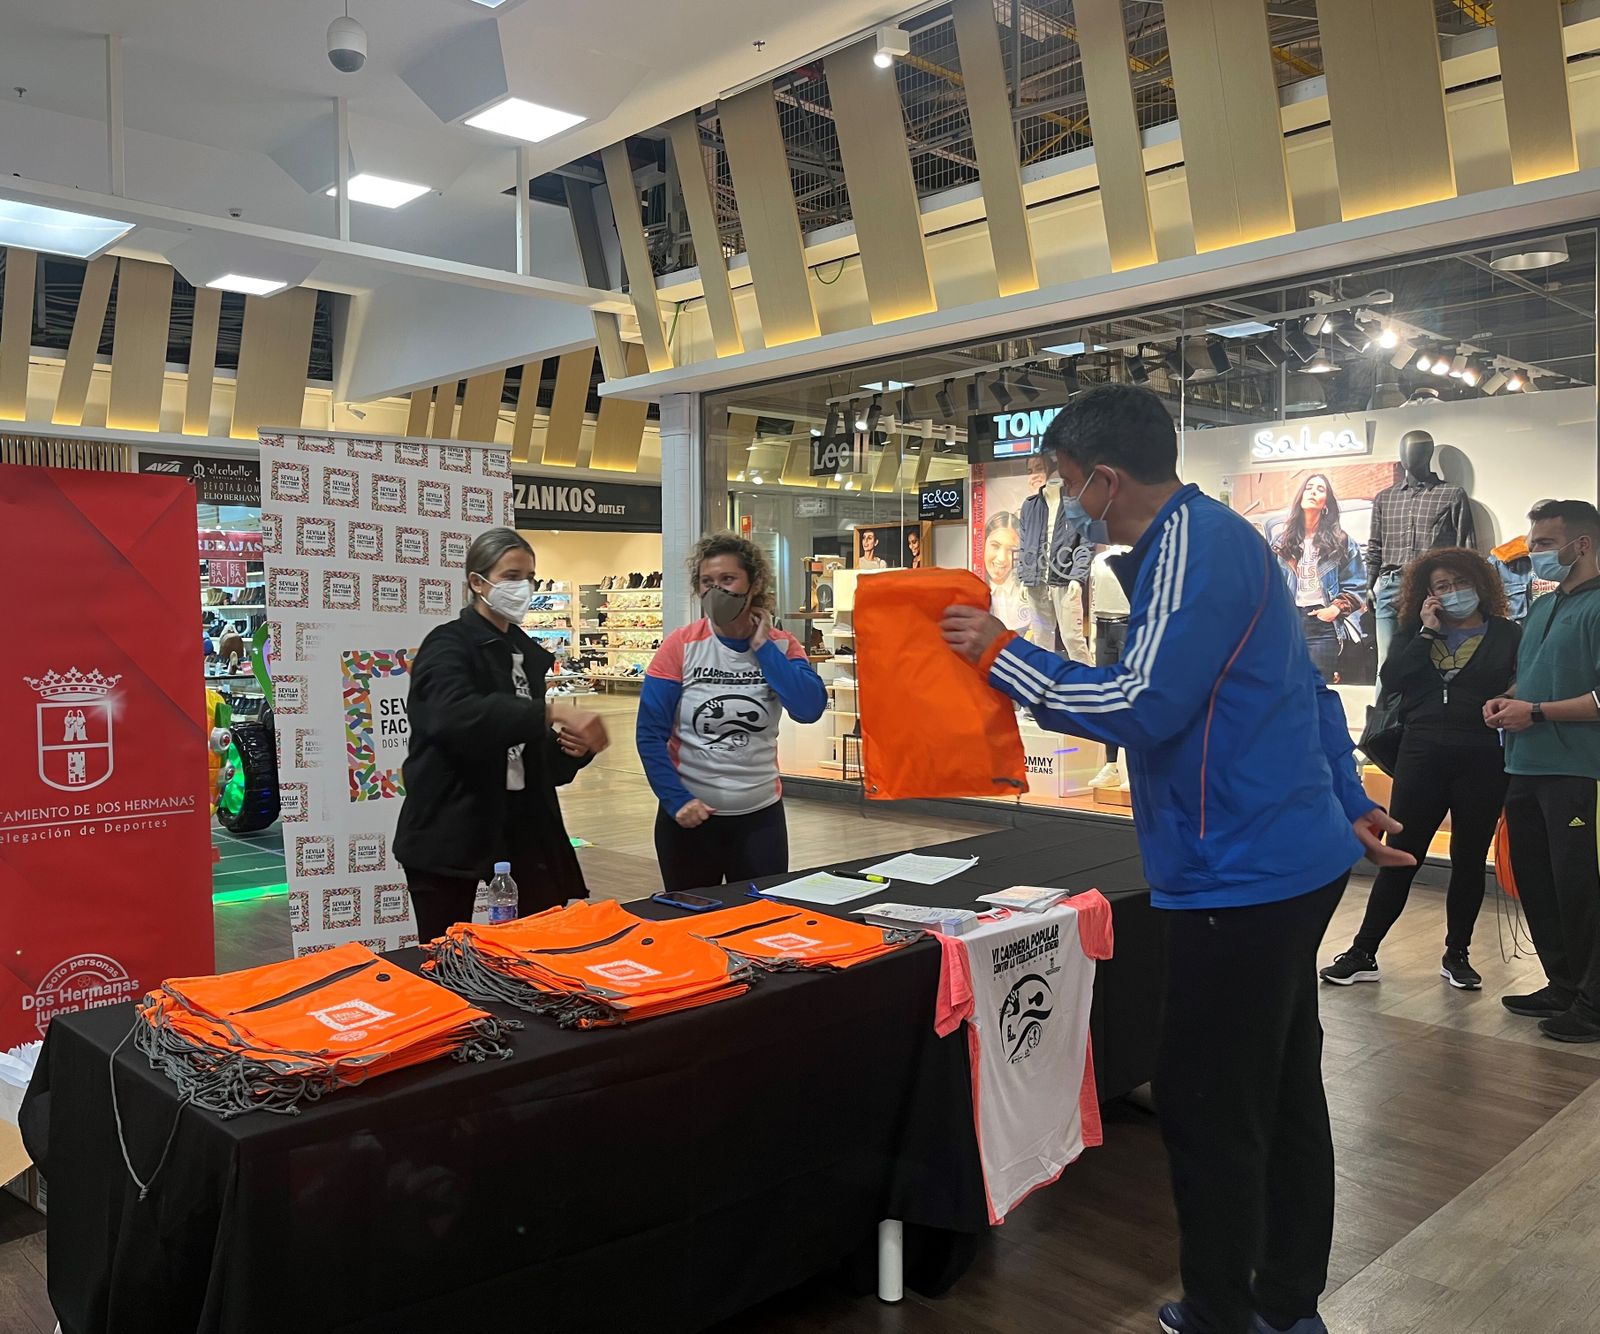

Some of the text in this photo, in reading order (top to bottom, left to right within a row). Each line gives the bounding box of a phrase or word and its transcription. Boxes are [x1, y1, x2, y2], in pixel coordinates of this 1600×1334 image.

[993, 408, 1063, 439] TOM
[1252, 426, 1364, 458] Salsa
[145, 461, 183, 472] AVIA
[813, 441, 850, 470] Lee
[514, 484, 596, 513] ZANKOS
[598, 505, 626, 514] OUTLET
[702, 668, 740, 678] CARRERA
[381, 718, 408, 735] FAC
[382, 738, 398, 748] DOS
[1030, 766, 1053, 774] JEANS
[74, 804, 90, 816] DE
[96, 802, 121, 814] DOS
[124, 795, 195, 812] HERMANAS
[80, 826, 96, 836] de
[104, 818, 167, 834] Deportes
[1000, 937, 1030, 960] CARRERA
[1030, 924, 1059, 948] POPULAR
[46, 959, 119, 990] solo personas
[22, 979, 139, 1011] Dos Hermanas
